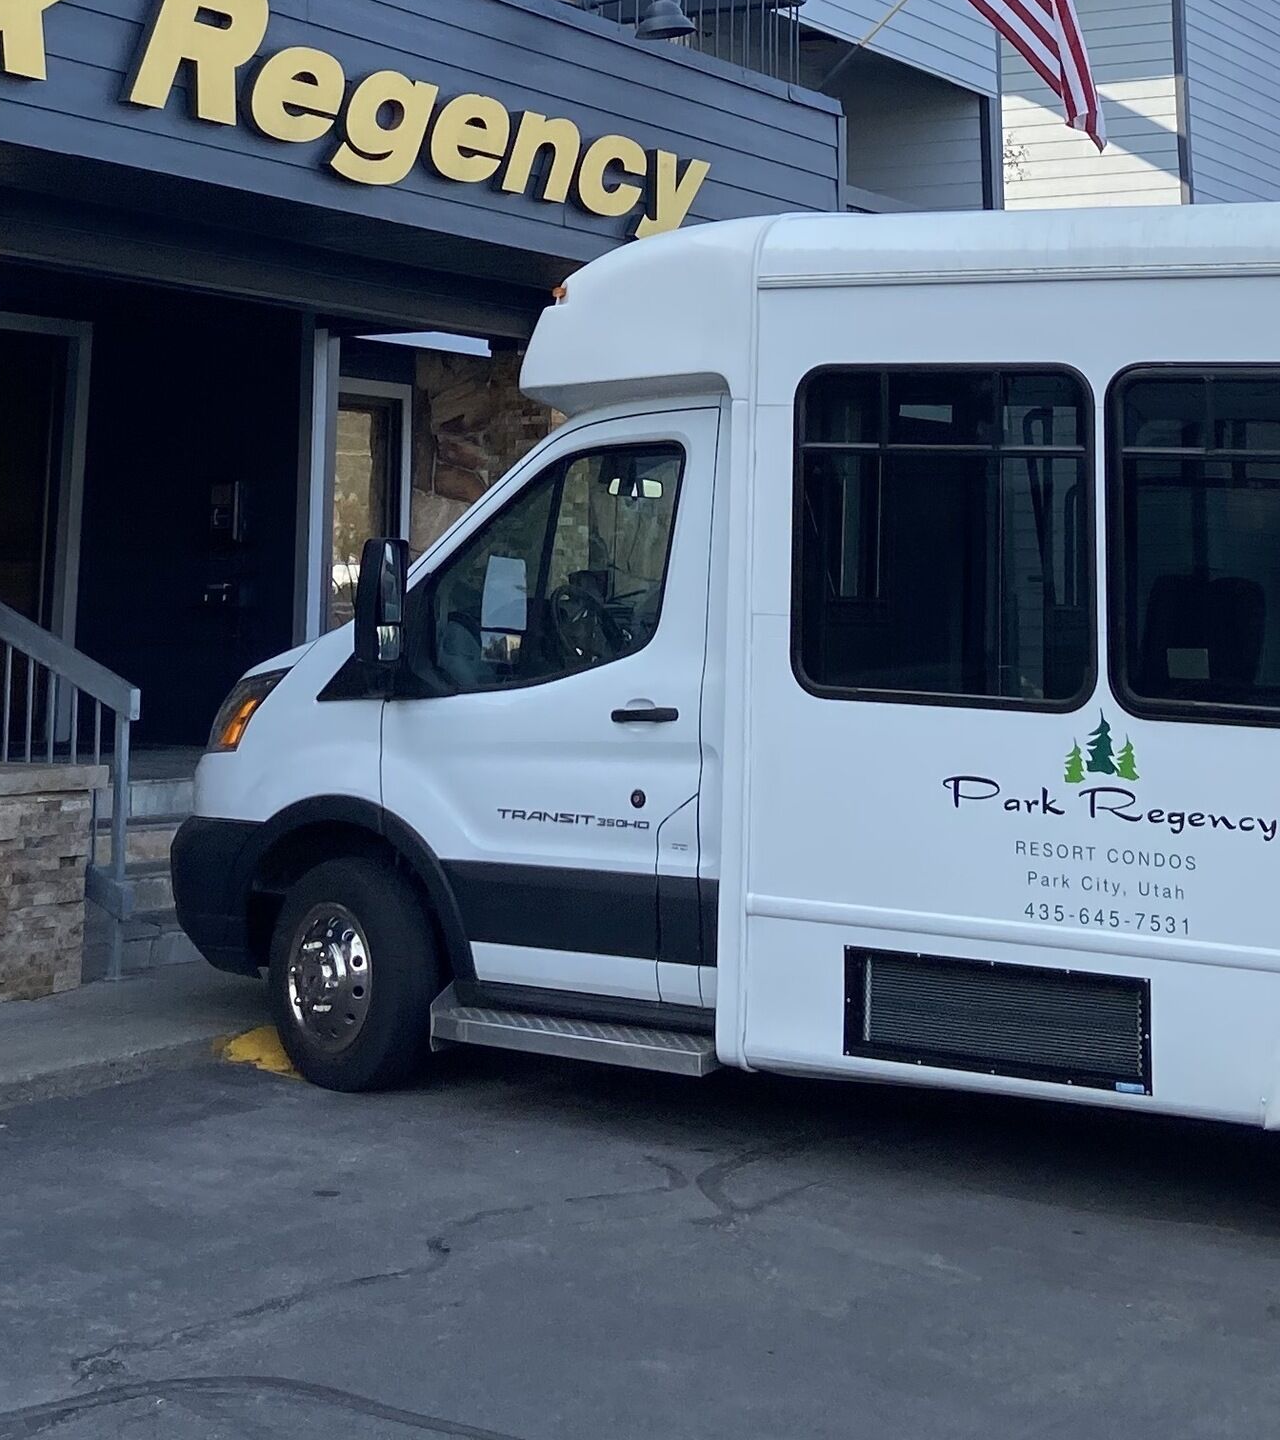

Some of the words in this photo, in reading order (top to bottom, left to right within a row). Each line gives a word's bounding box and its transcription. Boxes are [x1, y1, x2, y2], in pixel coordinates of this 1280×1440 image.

[497, 808, 596, 825] TRANSIT
[596, 817, 650, 830] 350HD
[942, 775, 1066, 816] Park
[1078, 787, 1278, 842] Regency
[1015, 840, 1097, 862] RESORT
[1106, 848, 1197, 871] CONDOS
[1027, 871, 1071, 890] Park
[1081, 875, 1128, 898] City,
[1138, 881, 1185, 901] Utah
[1024, 902, 1191, 935] 435-645-7531
